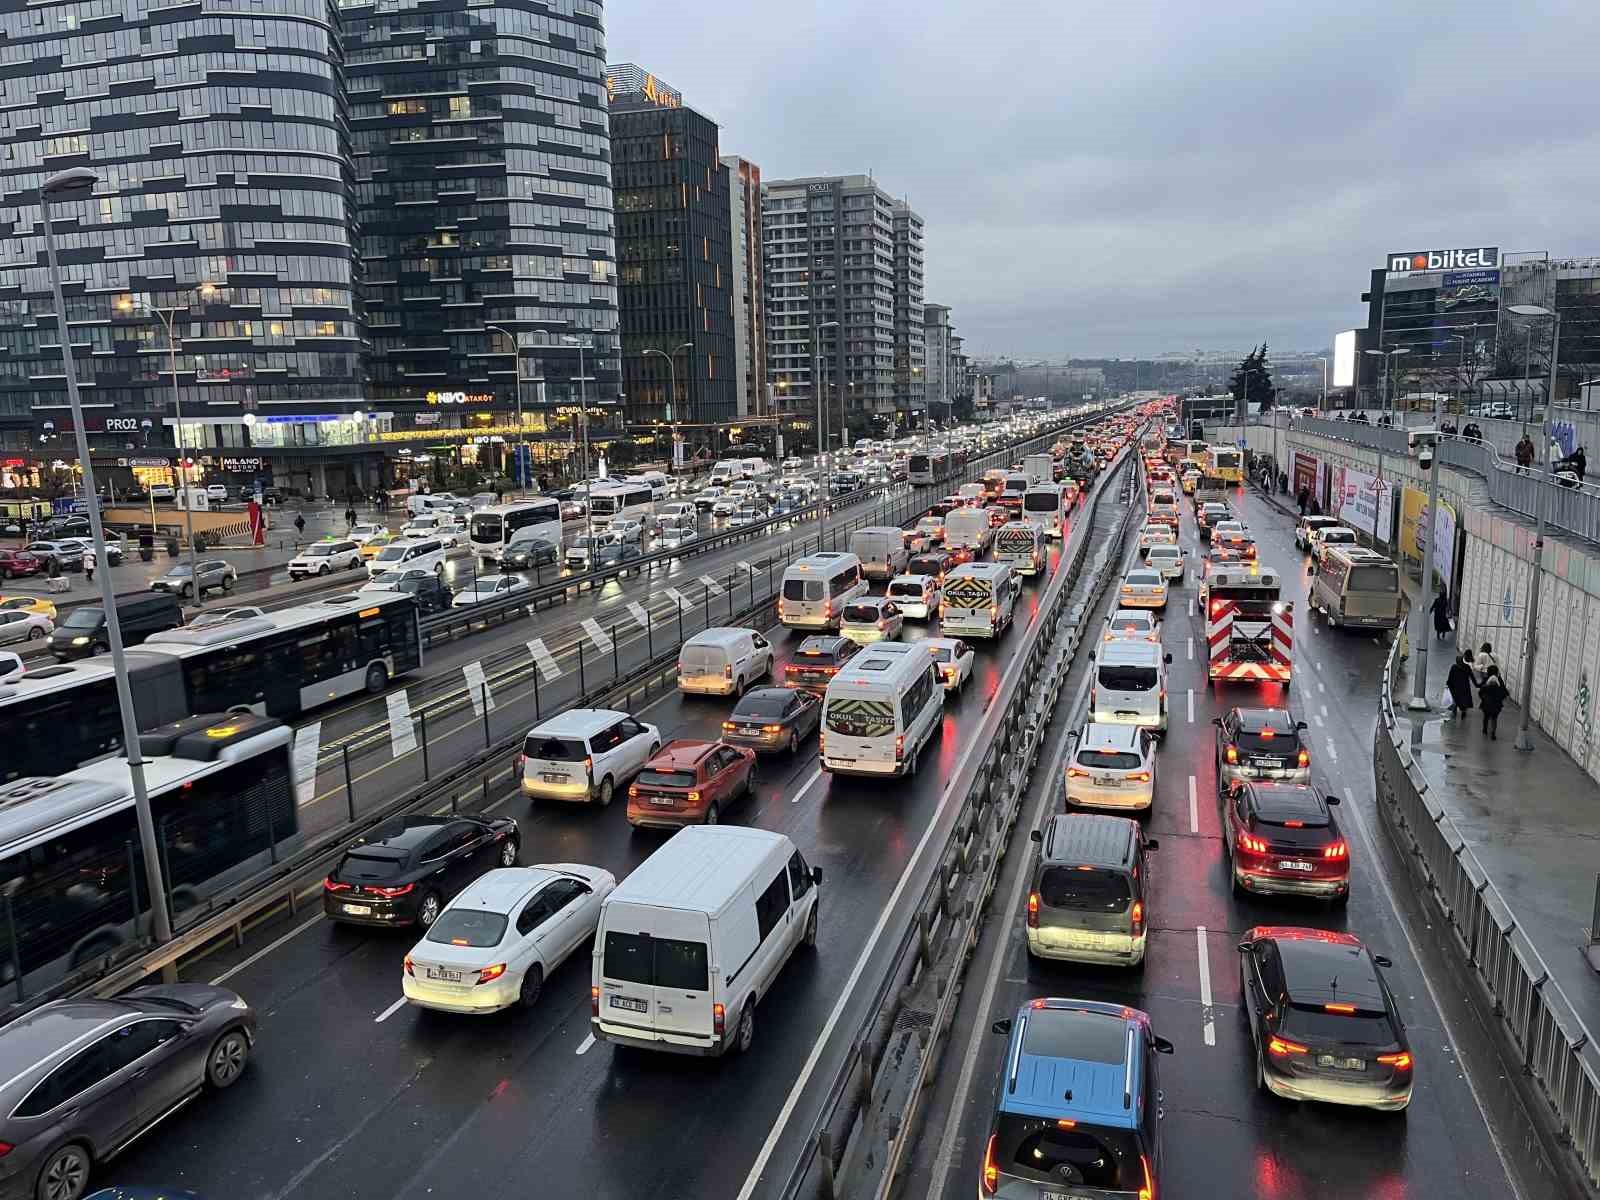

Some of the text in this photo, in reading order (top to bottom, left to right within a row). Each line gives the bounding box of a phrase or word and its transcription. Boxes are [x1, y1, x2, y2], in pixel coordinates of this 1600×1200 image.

[556, 406, 582, 414] NEVADA
[106, 418, 138, 430] PRO2
[830, 712, 854, 721] OKUL
